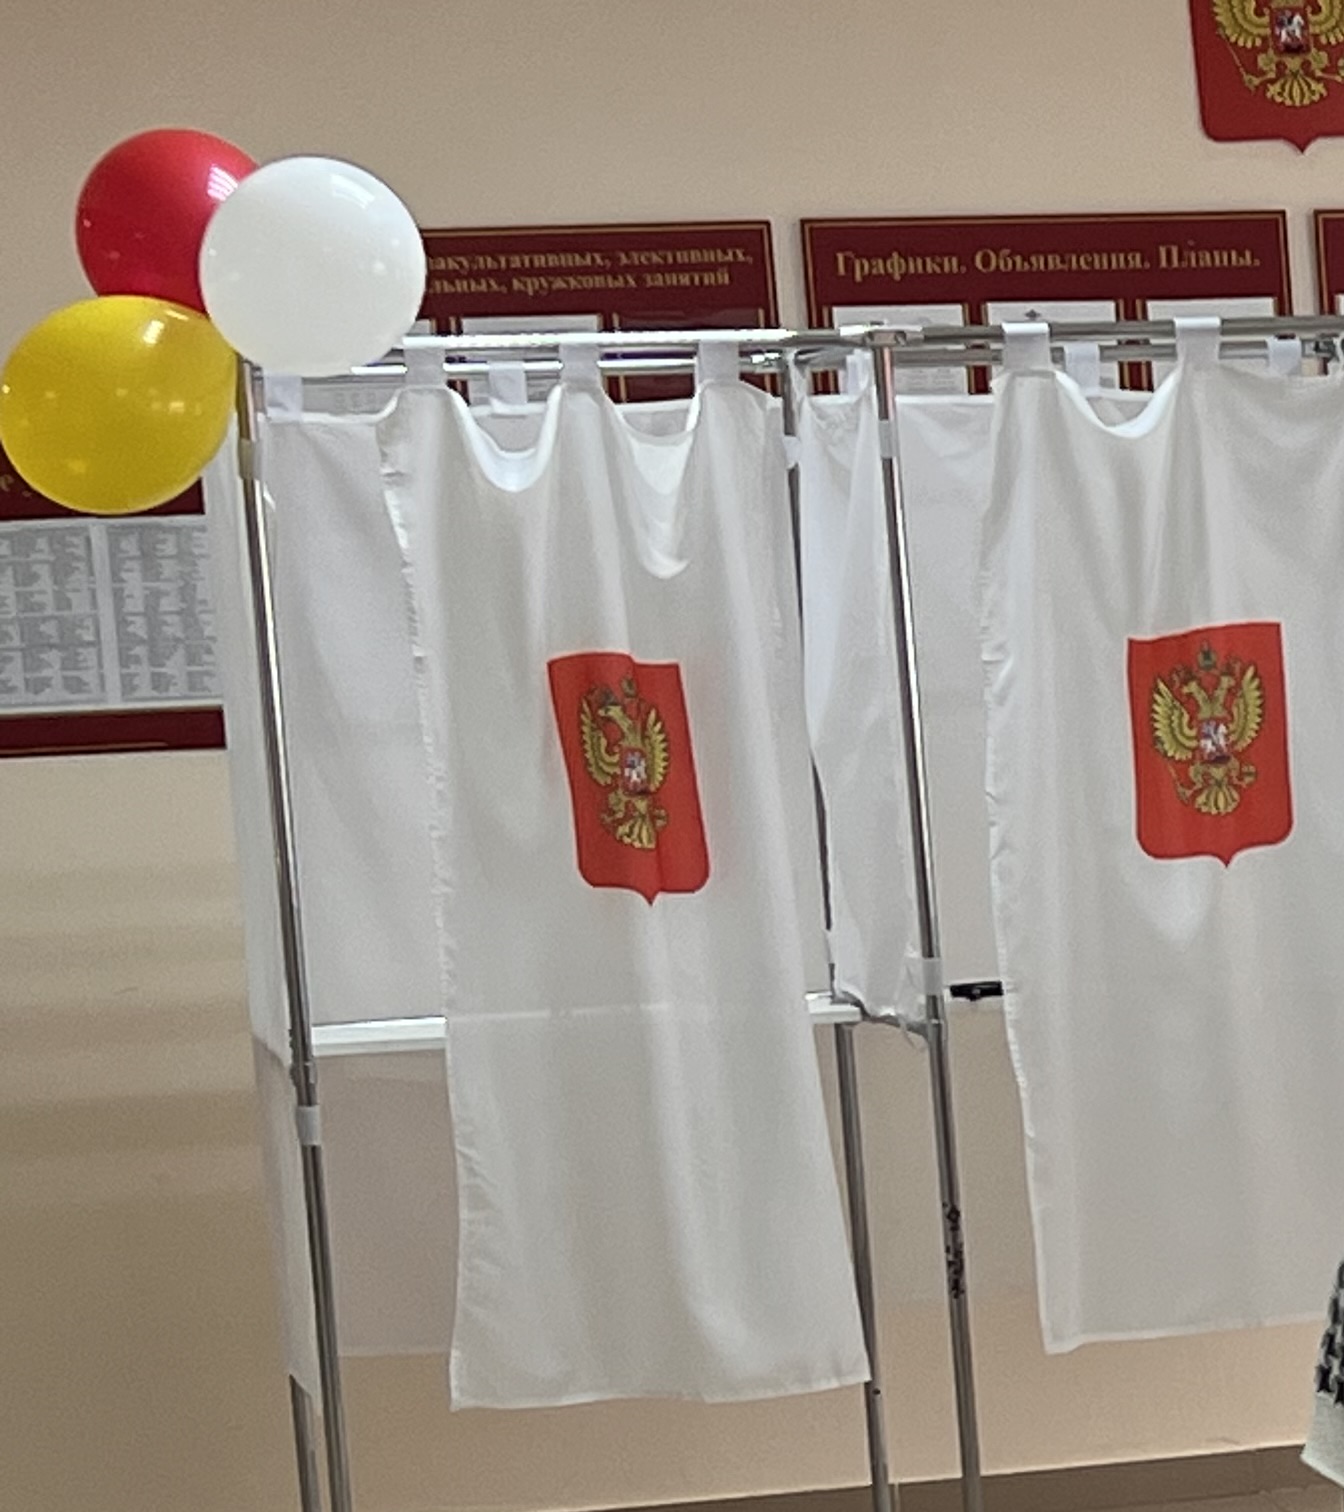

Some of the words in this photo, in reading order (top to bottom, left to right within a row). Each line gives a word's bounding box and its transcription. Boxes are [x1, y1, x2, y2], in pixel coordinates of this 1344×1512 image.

[428, 252, 611, 275] акультативных,
[835, 250, 966, 282] Графики.
[974, 247, 1150, 273] Объявления.
[1159, 244, 1261, 269] Планы.
[512, 273, 637, 298] кружковых
[646, 267, 730, 289] занятий
